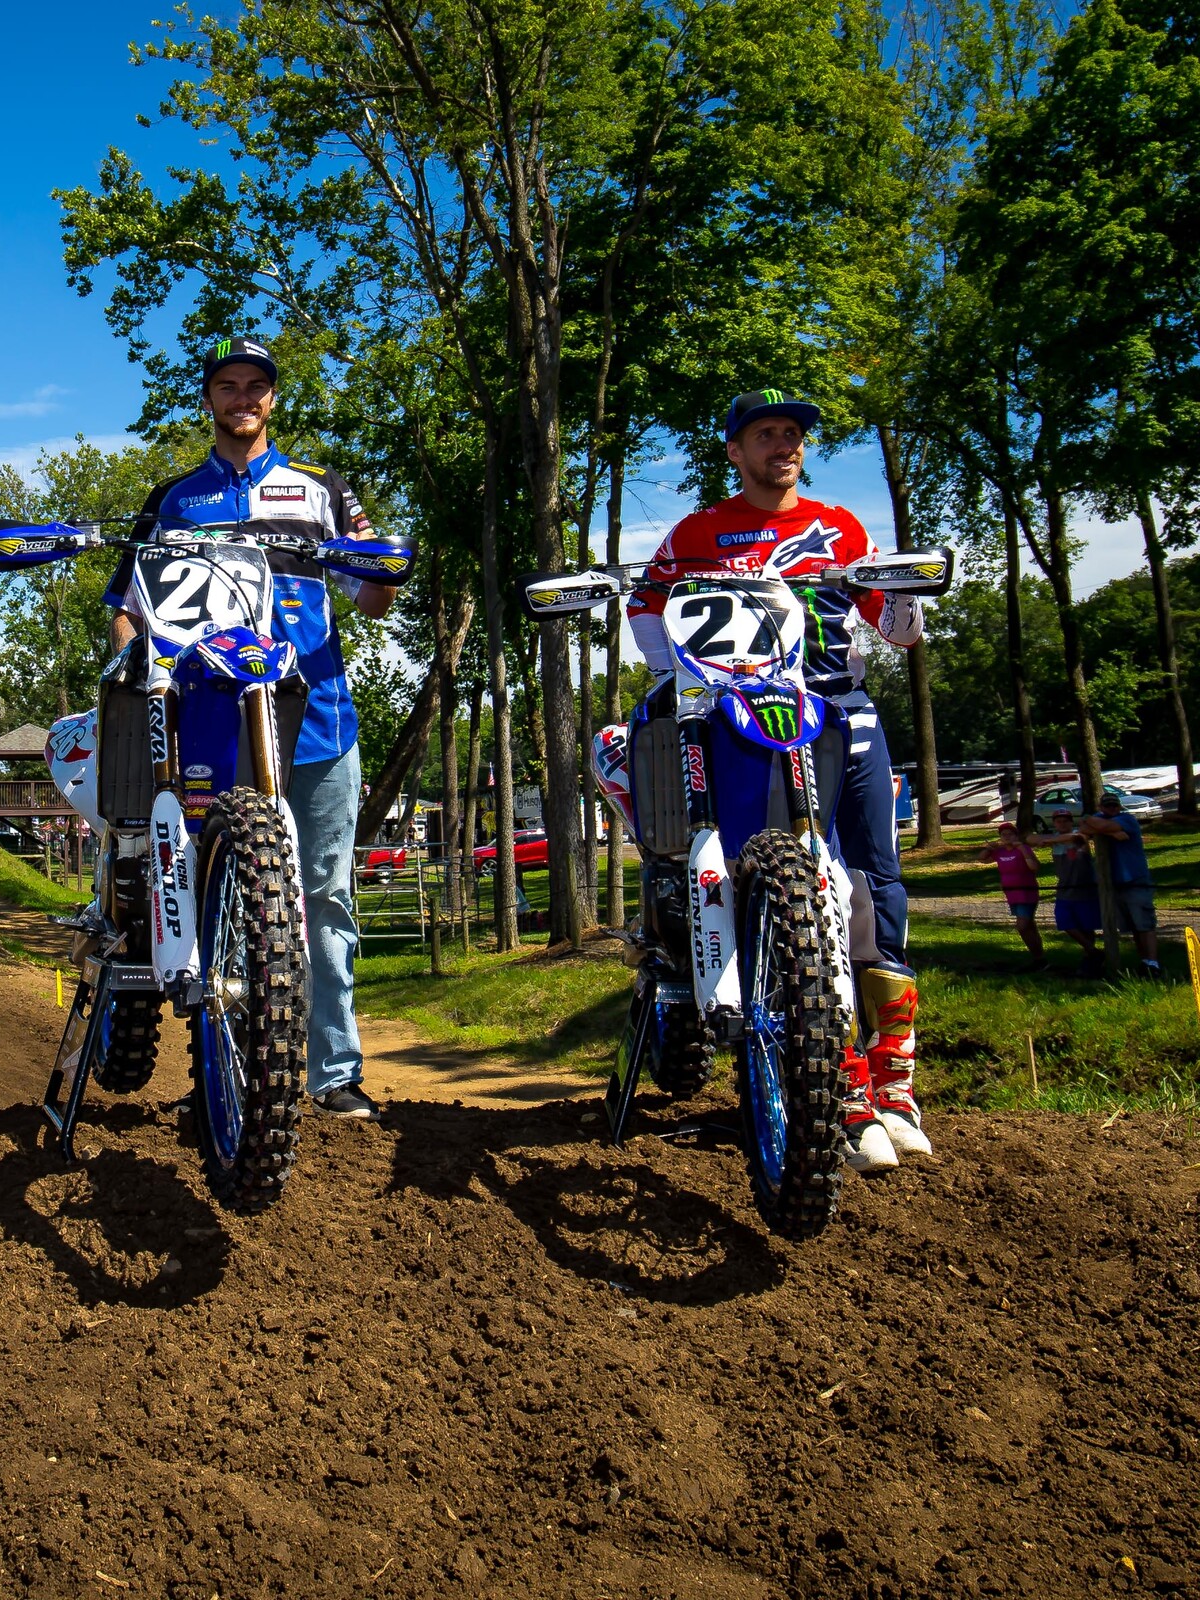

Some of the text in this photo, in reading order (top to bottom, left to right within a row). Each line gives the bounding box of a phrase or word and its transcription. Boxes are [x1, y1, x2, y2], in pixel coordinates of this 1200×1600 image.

[188, 491, 224, 507] YAMAHA
[262, 487, 304, 497] YAMALUBE
[731, 530, 775, 543] YAMAHA
[16, 539, 57, 551] CYCRA
[347, 556, 386, 569] CYCRA
[880, 569, 921, 577] CYCRA
[159, 558, 261, 626] 26
[554, 589, 592, 601] CYCRA
[680, 596, 790, 657] 27
[237, 650, 268, 660] YAMAHA
[751, 694, 796, 706] YAMAHA
[148, 697, 167, 763] KYB
[50, 720, 87, 761] 26
[687, 745, 707, 792] KYB
[156, 821, 181, 938] DLOP
[690, 867, 705, 979] DUNLOP
